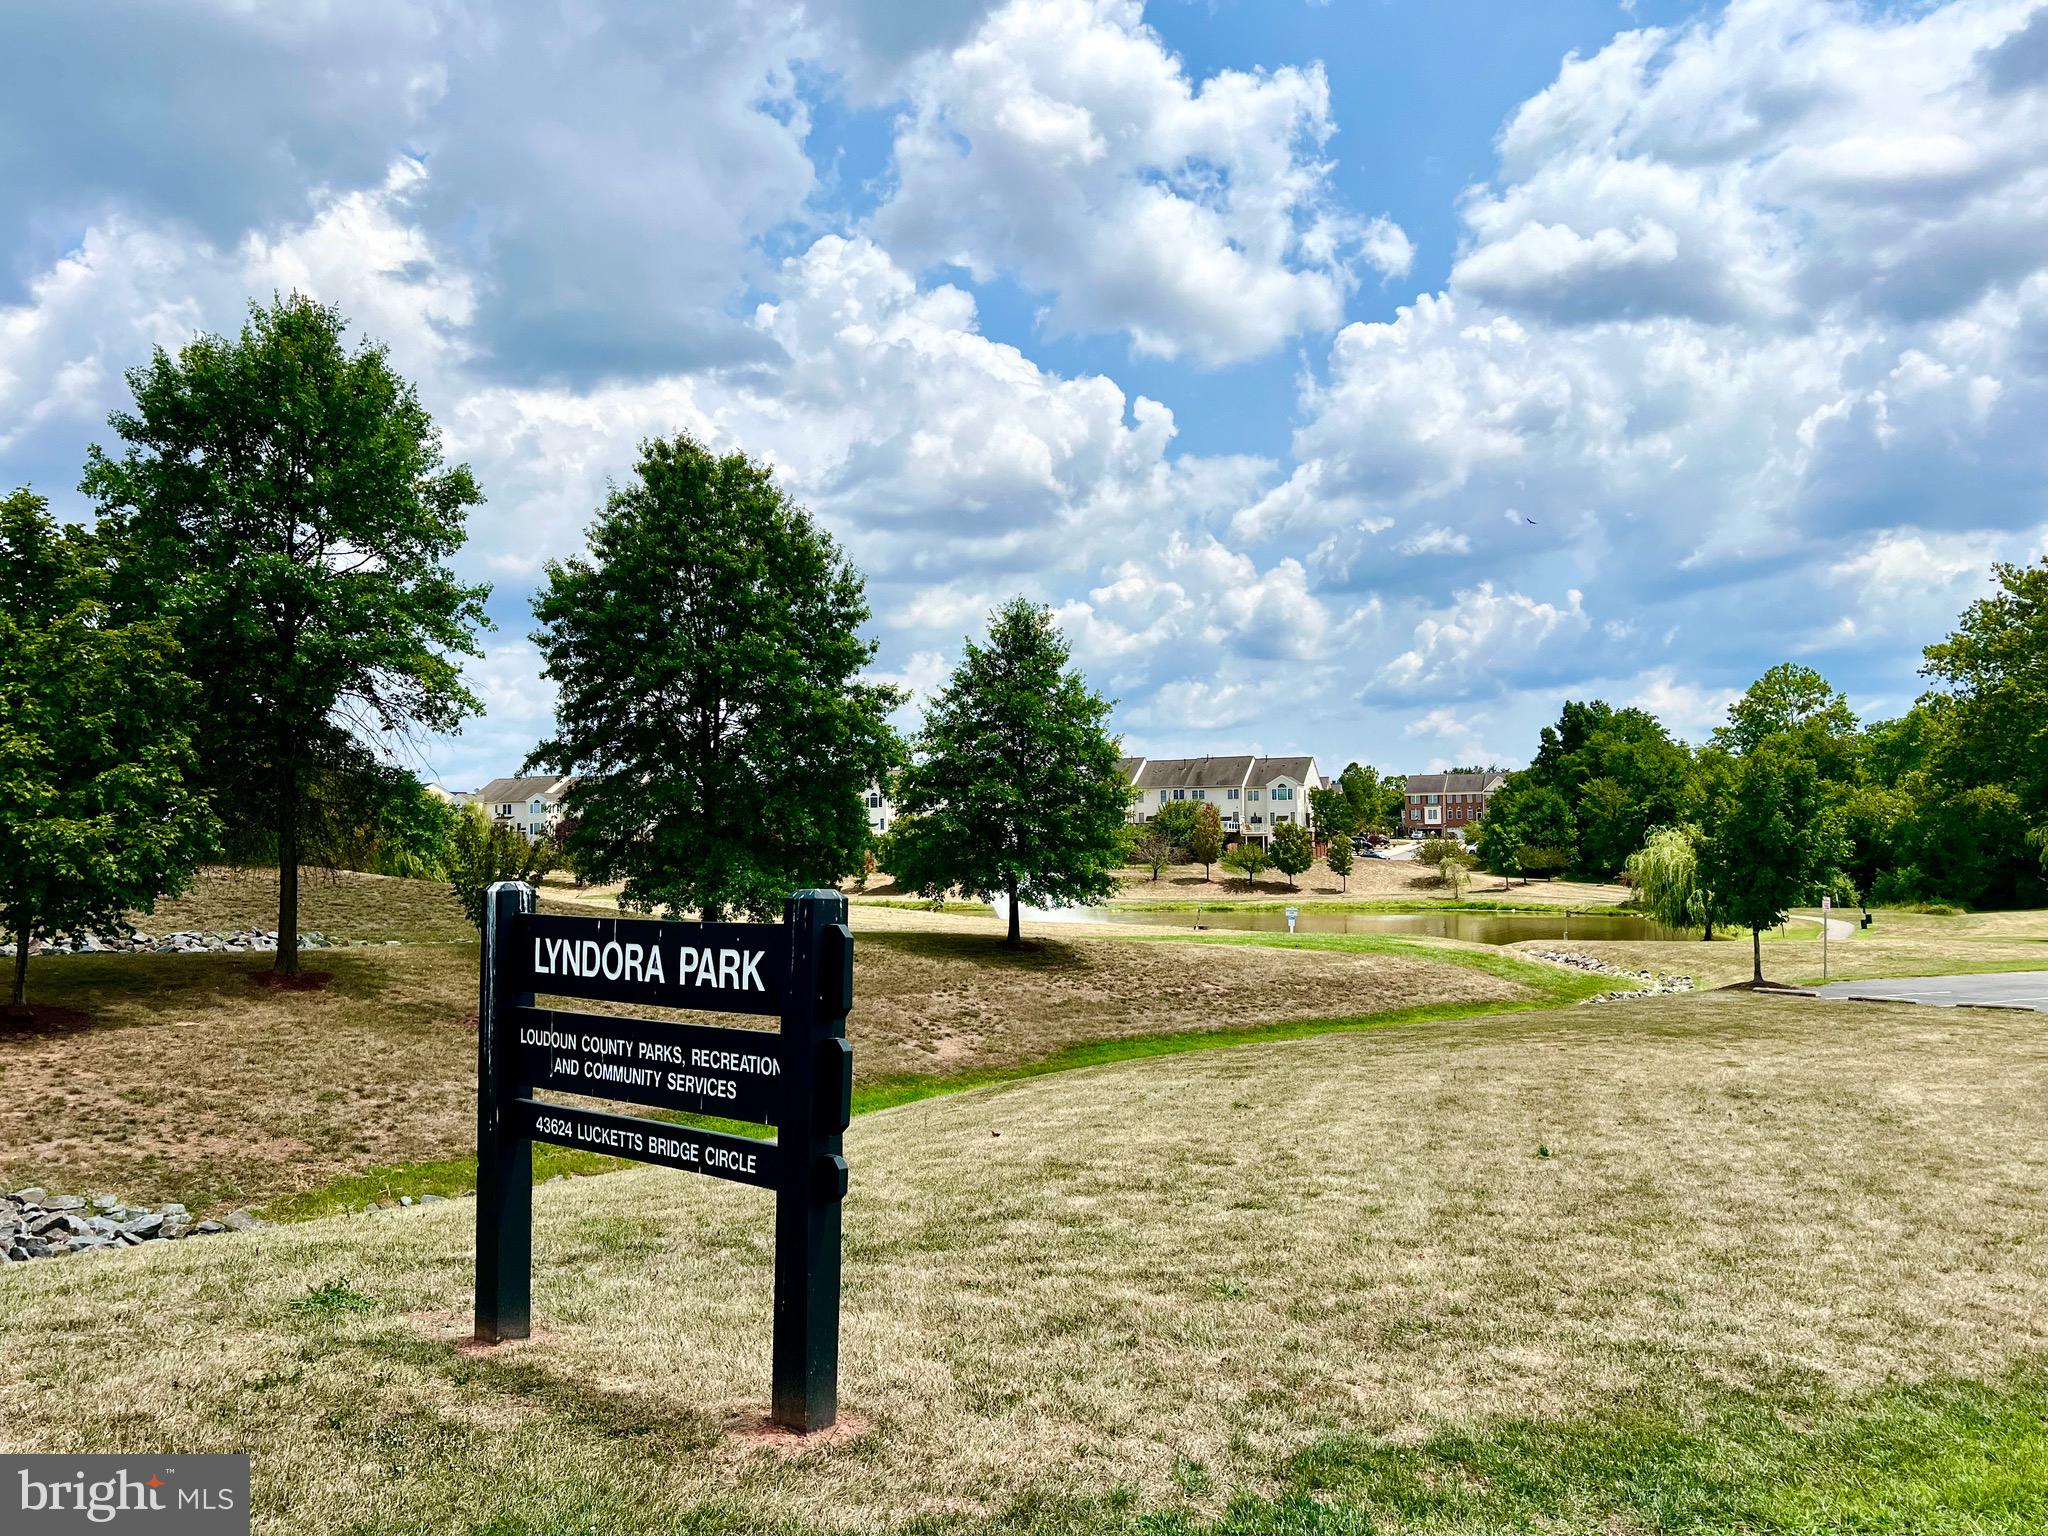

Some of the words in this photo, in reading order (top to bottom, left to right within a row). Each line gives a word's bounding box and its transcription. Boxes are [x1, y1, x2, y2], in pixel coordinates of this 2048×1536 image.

[534, 937, 665, 984] LYNDORA
[679, 946, 766, 992] PARK
[520, 1027, 577, 1051] LOUDOUN
[581, 1035, 634, 1058] COUNTY
[638, 1042, 686, 1068] PARKS,
[553, 1057, 579, 1076] AND
[584, 1061, 662, 1088] COMMUNITY
[667, 1072, 737, 1100] SERVICES
[535, 1116, 573, 1138] 43624
[577, 1123, 643, 1151] LUCKETTS
[648, 1136, 700, 1162] BRIDGE
[704, 1146, 757, 1174] CIRCLE
